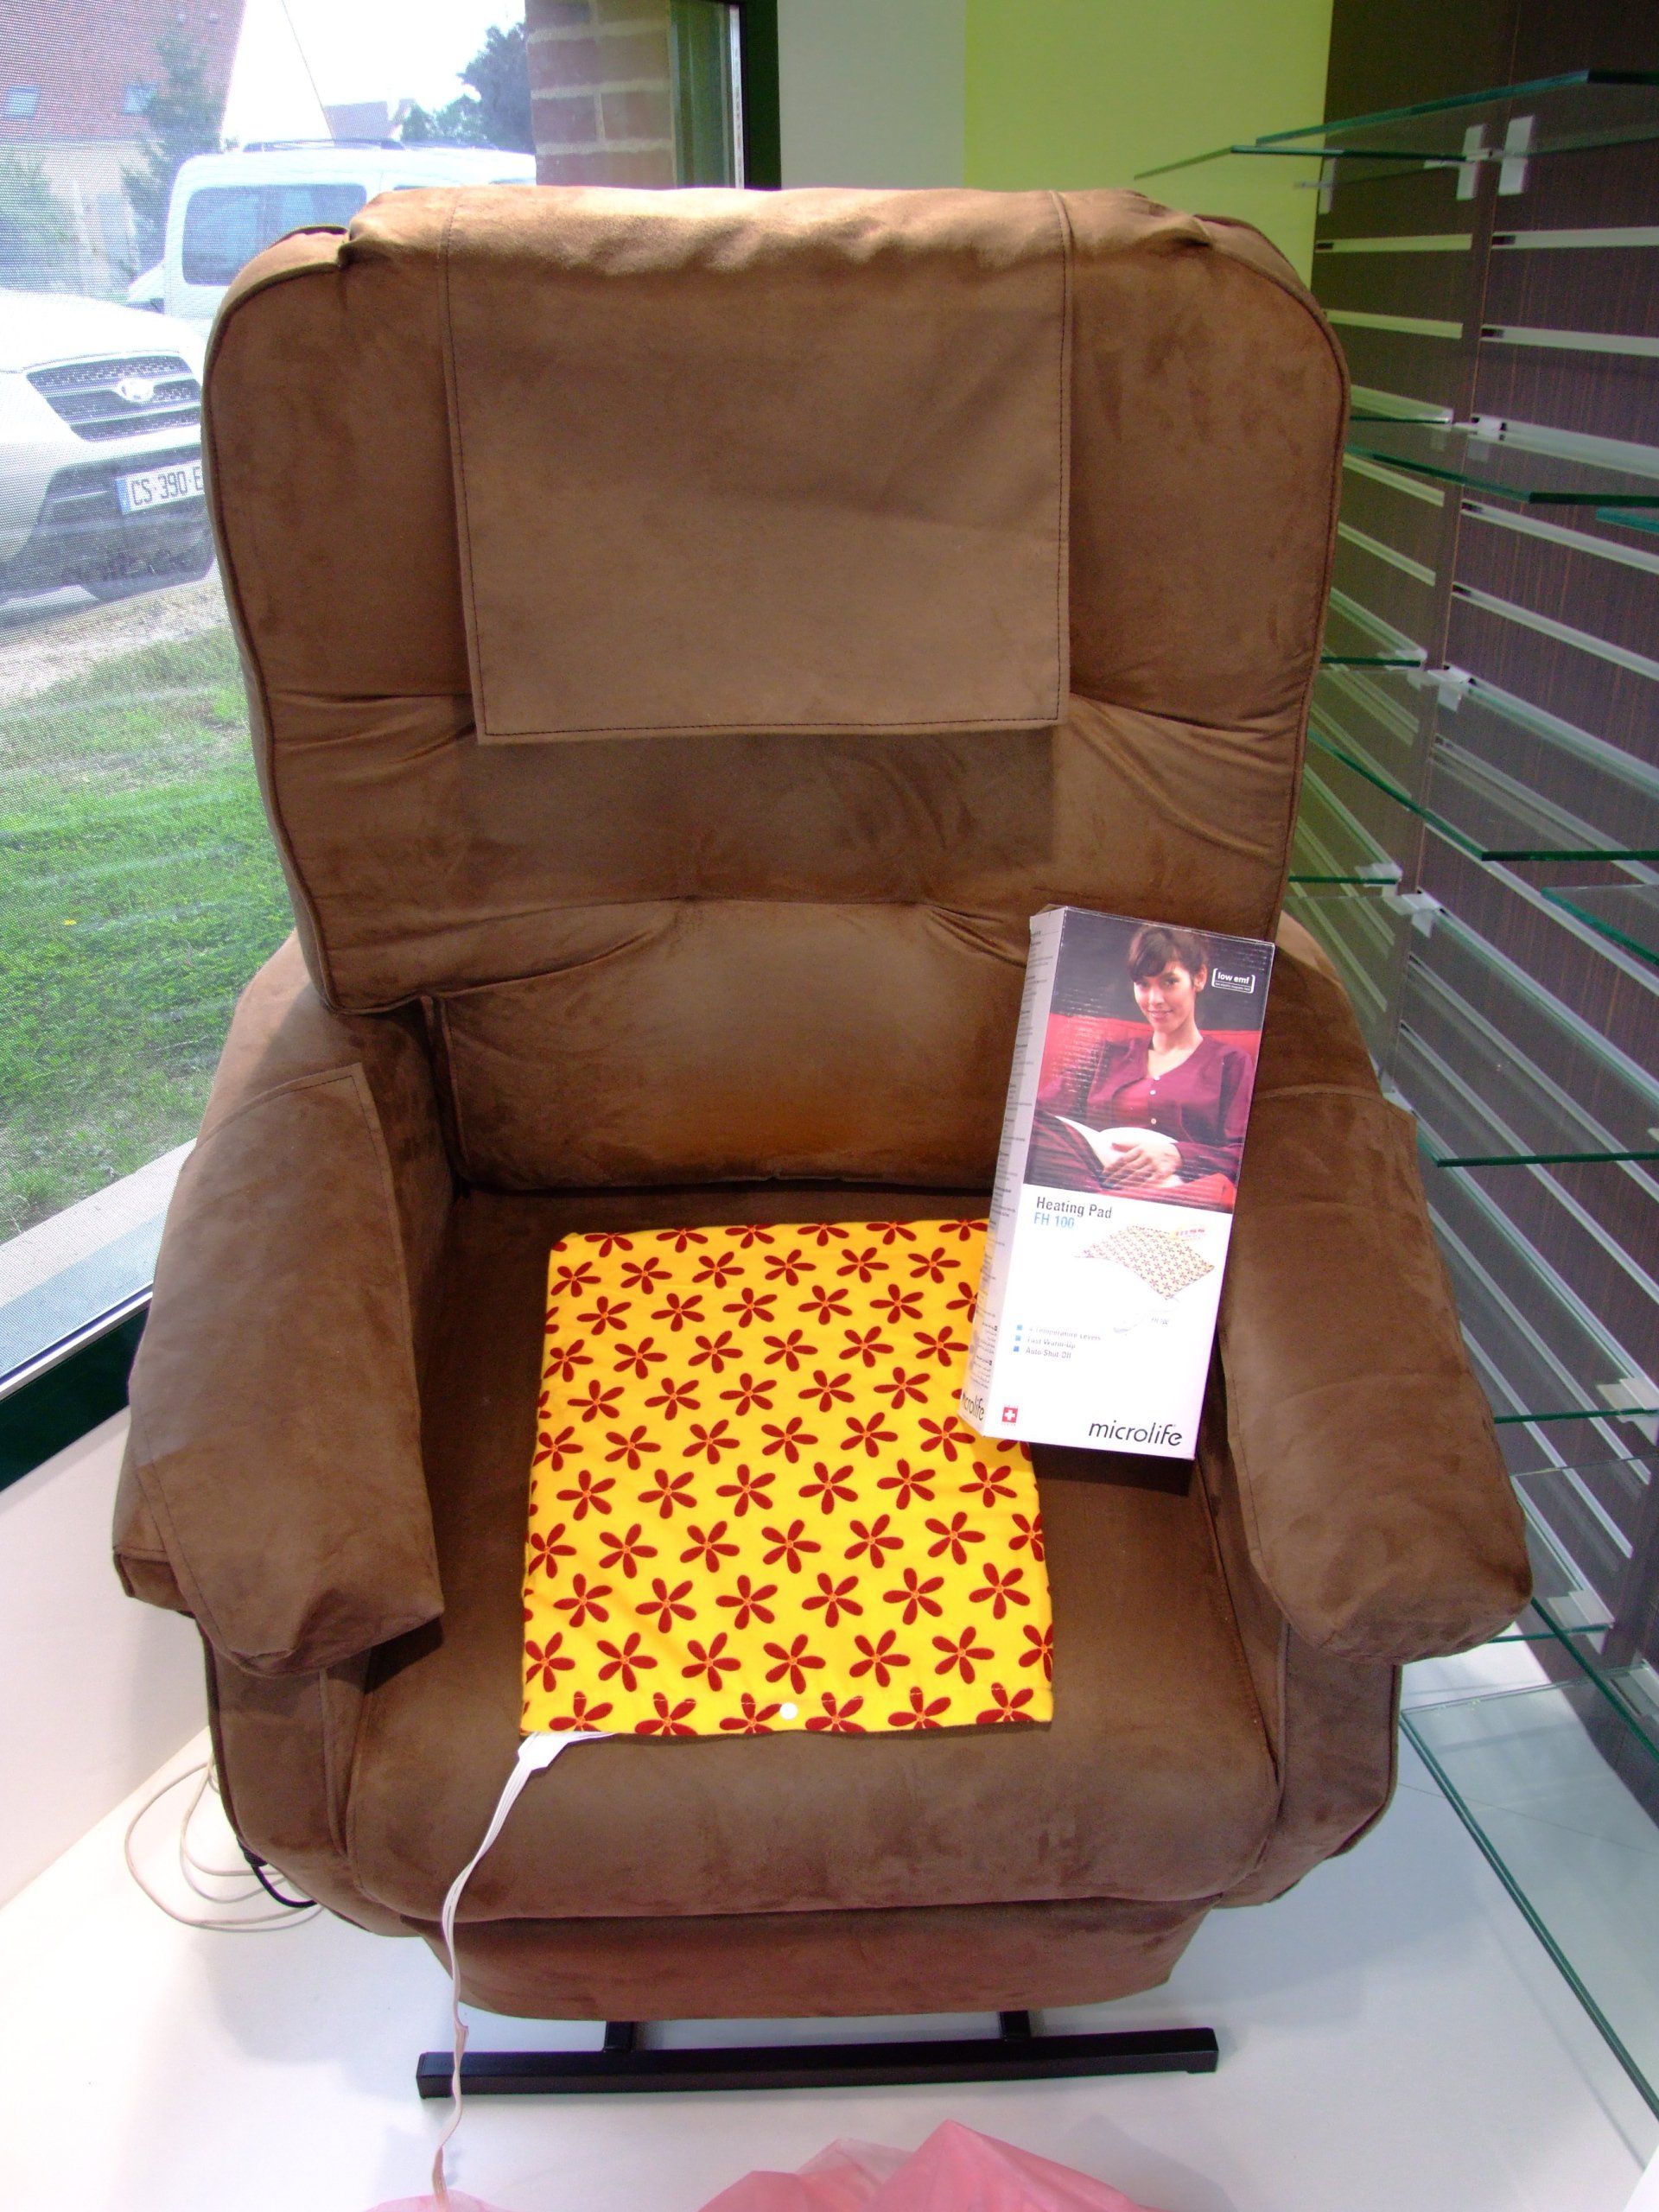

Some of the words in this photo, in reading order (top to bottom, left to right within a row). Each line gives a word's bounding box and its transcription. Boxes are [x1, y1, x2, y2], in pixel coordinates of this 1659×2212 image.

[1217, 972, 1233, 981] low
[1037, 1196, 1084, 1217] Heating
[1089, 1204, 1112, 1218] Pad
[1034, 1211, 1050, 1225] FH
[1055, 1215, 1075, 1229] 100
[1026, 1346, 1042, 1356] Auto
[1089, 1420, 1182, 1446] microlife
